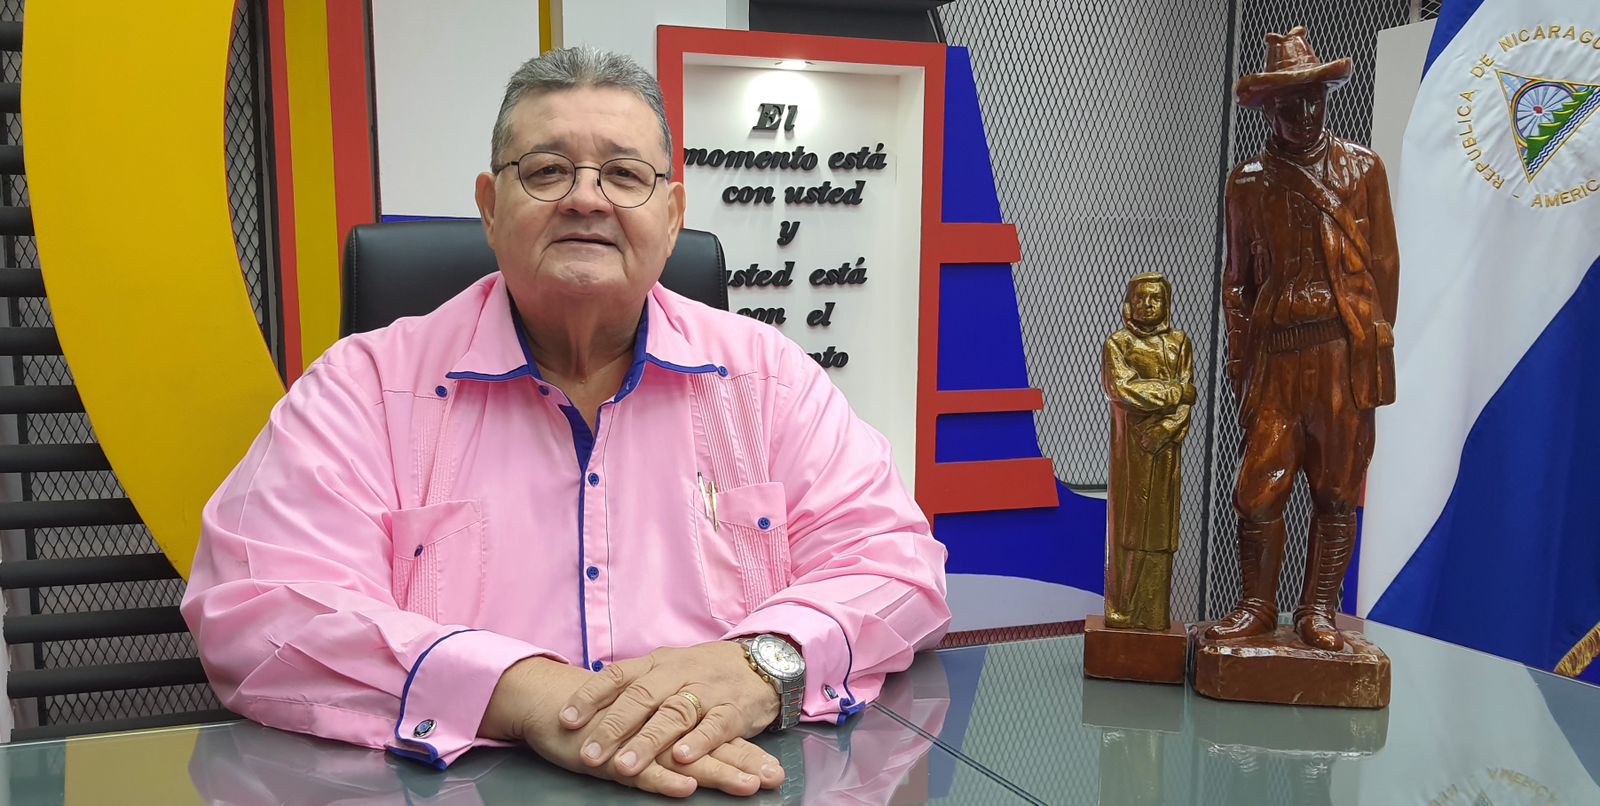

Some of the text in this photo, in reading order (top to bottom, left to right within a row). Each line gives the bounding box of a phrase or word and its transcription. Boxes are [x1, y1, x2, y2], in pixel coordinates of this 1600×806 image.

[1470, 54, 1495, 79] DE
[752, 103, 798, 131] El
[1457, 89, 1505, 190] REPUBLICA
[684, 143, 888, 171] momento está
[722, 180, 866, 206] con usted
[777, 220, 800, 246] y
[809, 257, 868, 286] está
[806, 302, 836, 327] el
